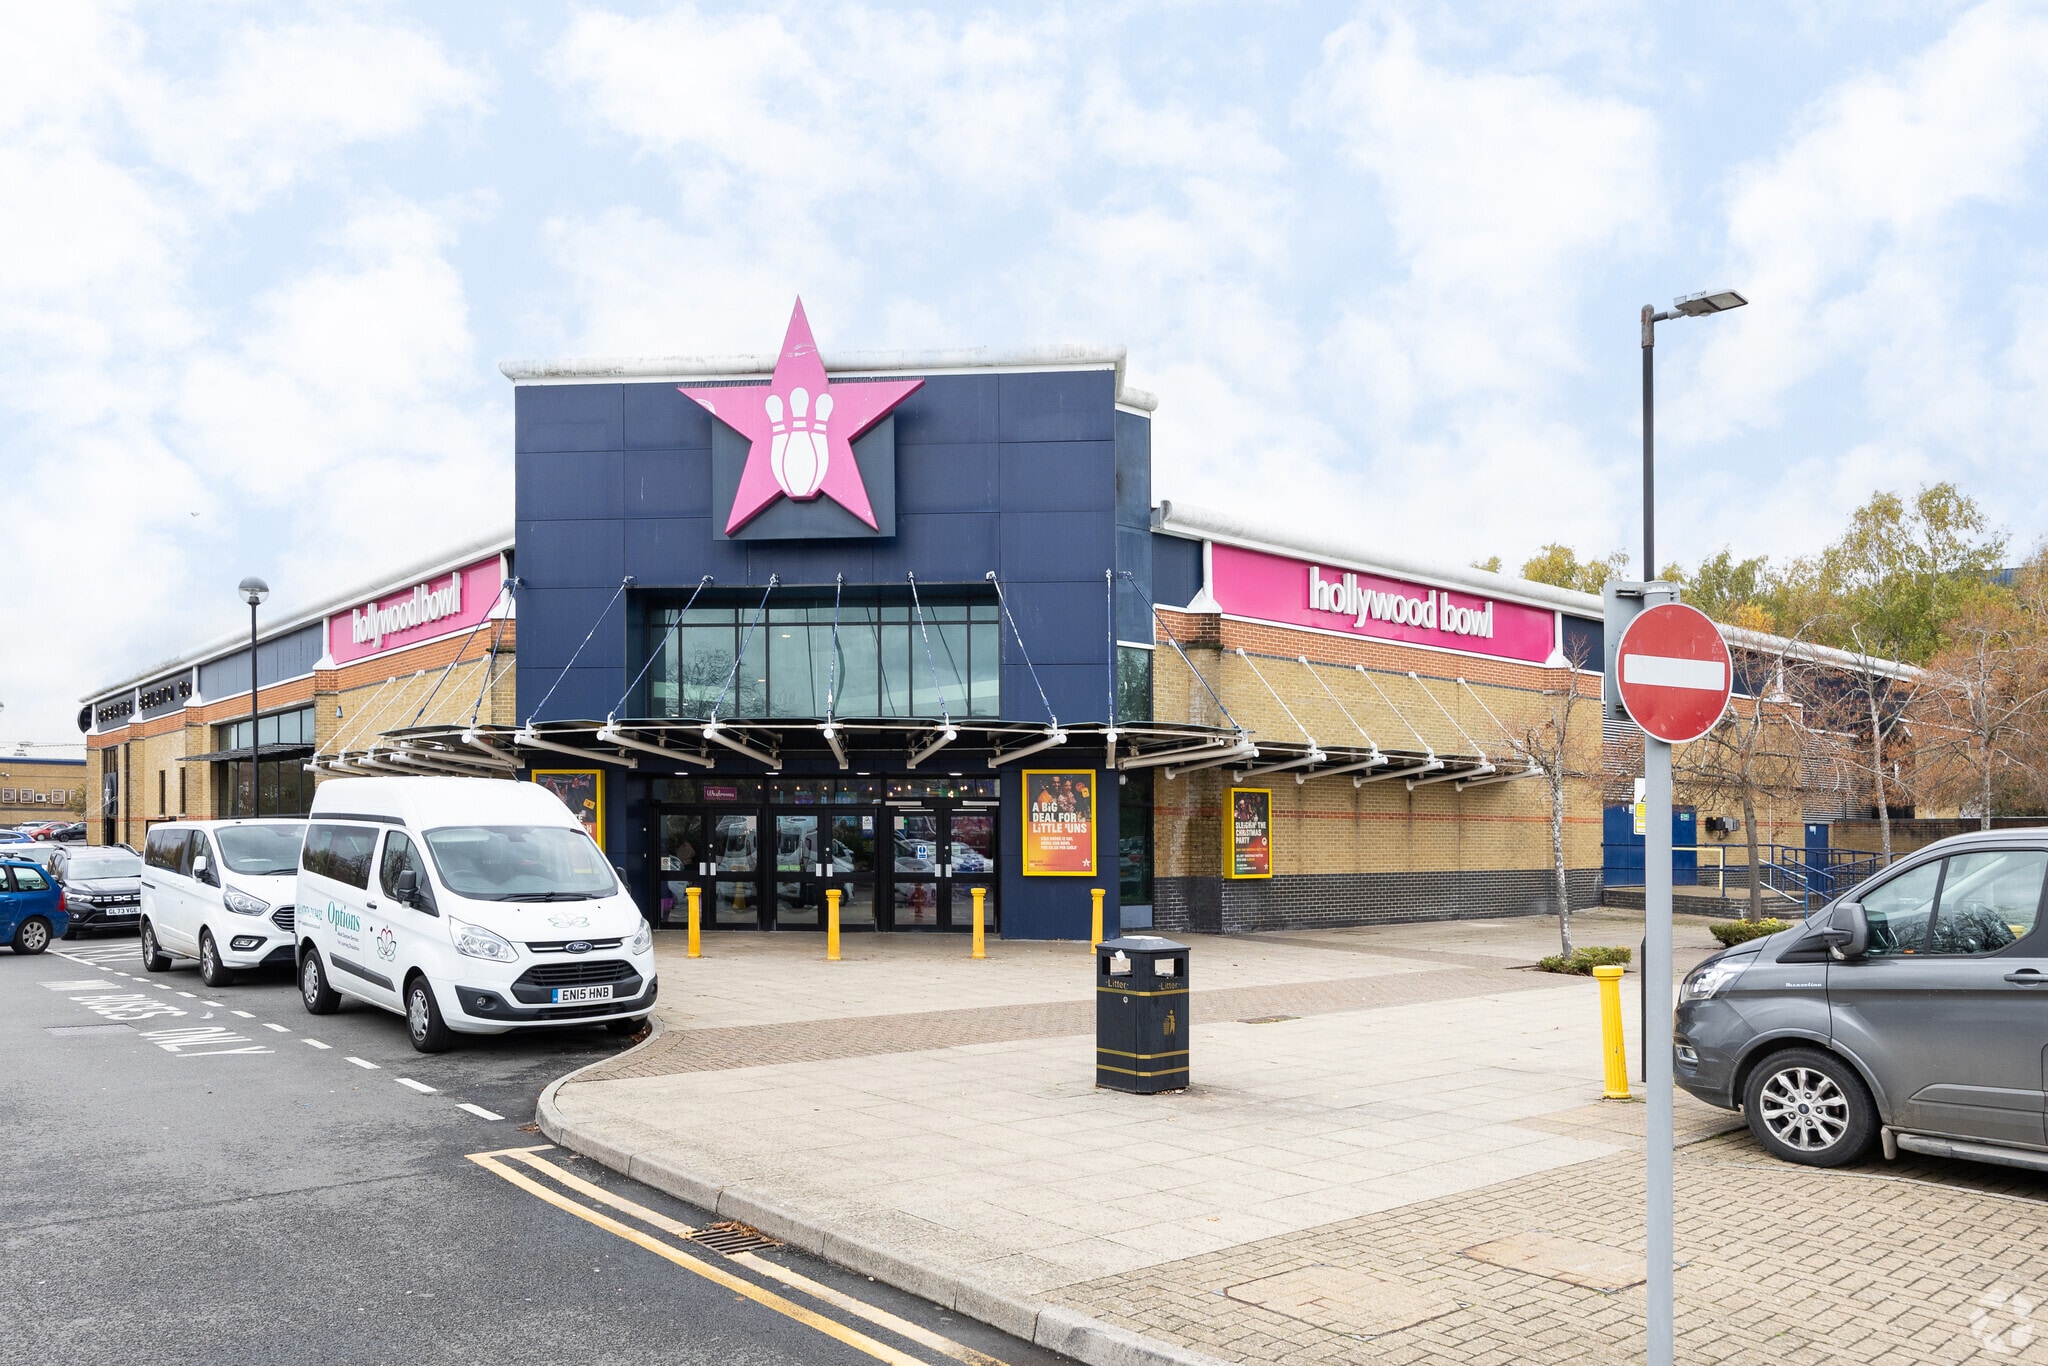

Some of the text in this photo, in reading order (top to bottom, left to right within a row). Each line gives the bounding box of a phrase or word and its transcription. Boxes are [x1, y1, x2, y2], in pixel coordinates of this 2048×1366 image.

[1309, 566, 1493, 639] hollywood bowl
[352, 571, 462, 648] hollywood bowl
[1032, 802, 1040, 813] A
[1032, 812, 1077, 823] DEAL FOR
[1257, 821, 1267, 829] THE
[328, 901, 360, 932] Options
[572, 943, 588, 951] Ford
[1107, 978, 1127, 989] Litter
[1160, 981, 1178, 990] Litter
[562, 986, 609, 1001] EN15 HNB
[69, 994, 188, 1020] BUSES
[138, 1026, 275, 1057] ONLY
